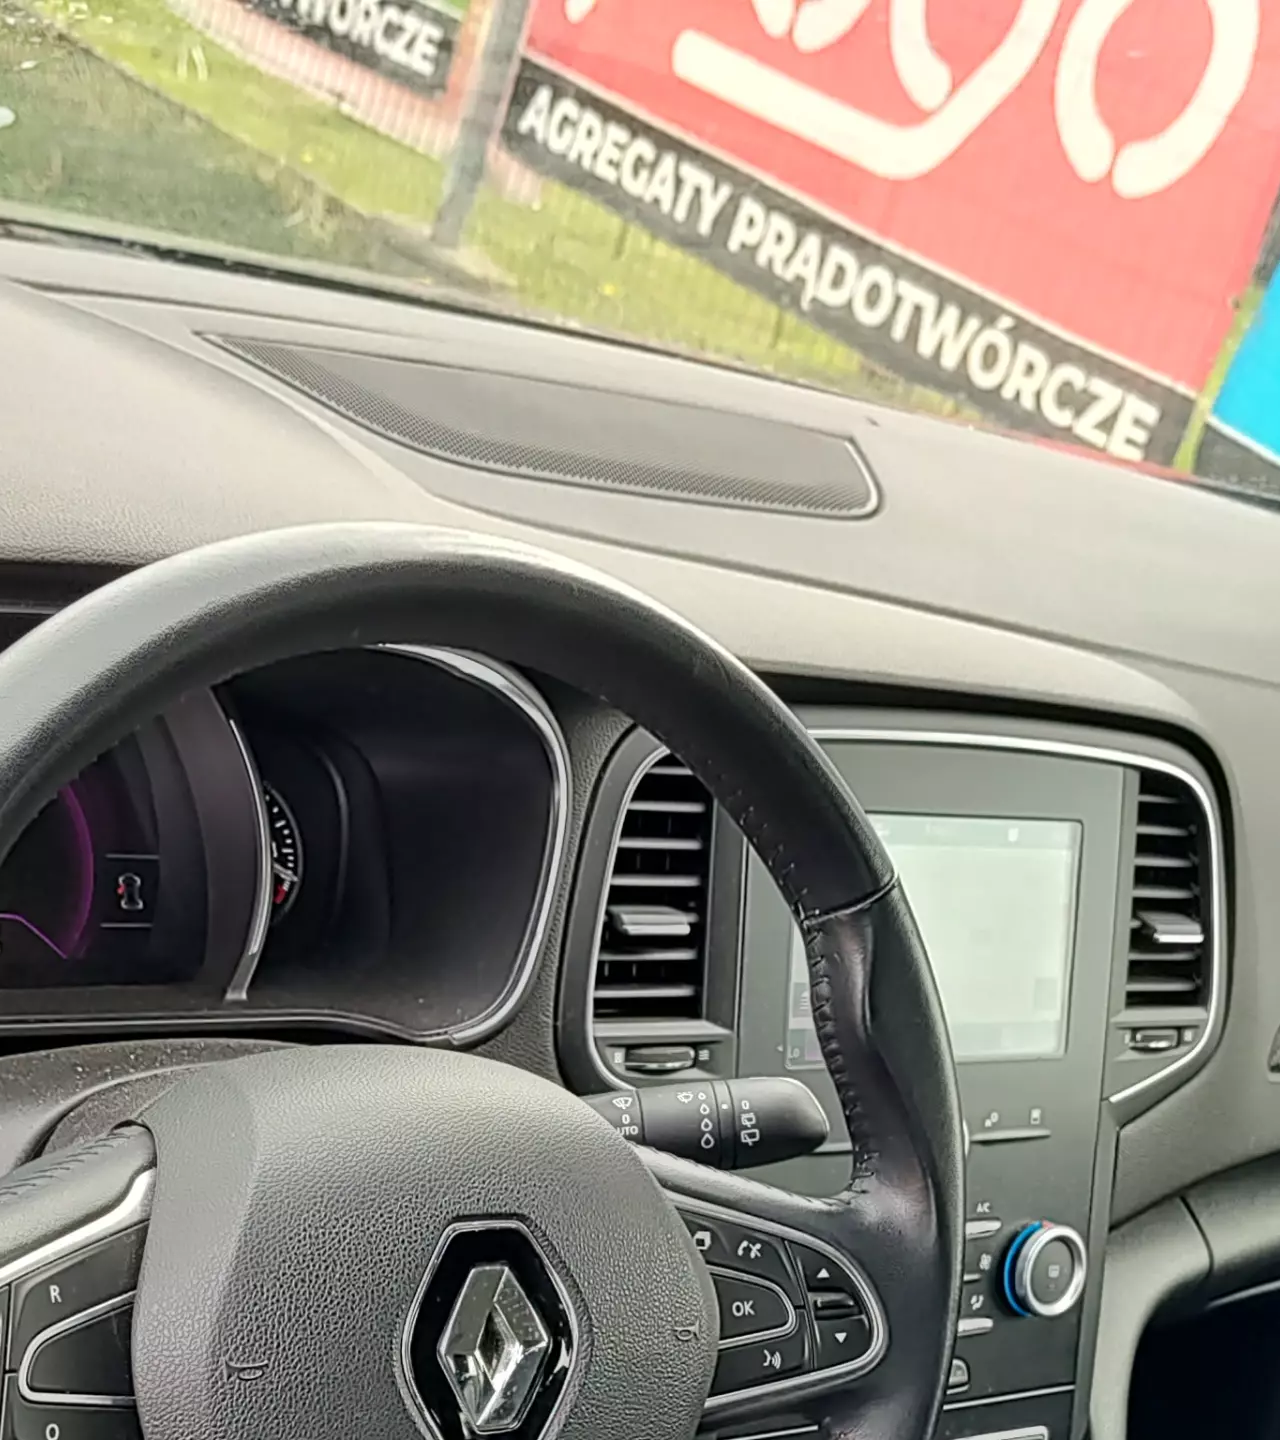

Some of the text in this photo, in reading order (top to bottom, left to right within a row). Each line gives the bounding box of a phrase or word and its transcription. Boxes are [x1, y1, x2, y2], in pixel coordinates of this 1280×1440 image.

[517, 86, 1161, 464] AGREGATY PRĄDOTWÓRCZE
[616, 1125, 639, 1136] UTO
[49, 1284, 62, 1304] R
[731, 1302, 755, 1317] OK
